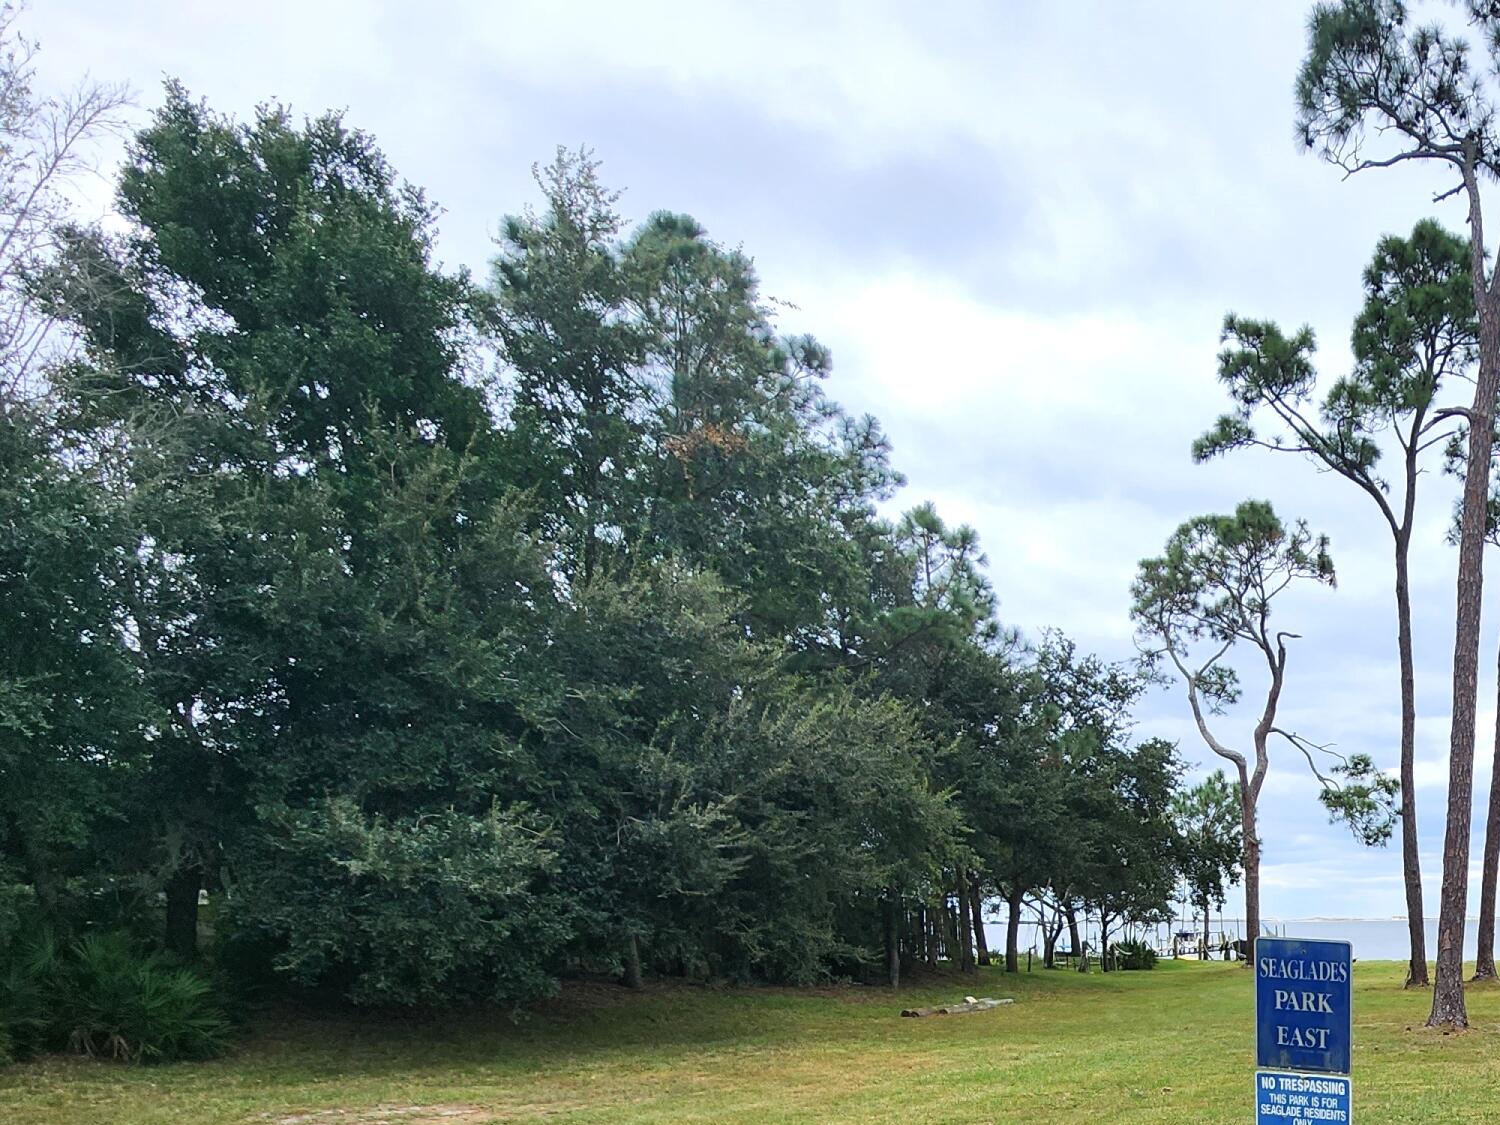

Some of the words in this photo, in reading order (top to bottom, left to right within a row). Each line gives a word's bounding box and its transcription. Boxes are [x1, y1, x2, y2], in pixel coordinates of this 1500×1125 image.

[1260, 957, 1347, 983] SEAGLADES
[1274, 990, 1334, 1013] PARK
[1277, 1025, 1330, 1049] EAST
[1261, 1077, 1275, 1090] NO
[1279, 1078, 1345, 1096] TRESPASSING
[1269, 1094, 1287, 1105] THIS
[1289, 1094, 1309, 1106] PARK
[1312, 1097, 1320, 1108] IS
[1322, 1097, 1338, 1109] FOR
[1261, 1105, 1302, 1117] SEAGLADE
[1304, 1108, 1346, 1121] RESIDENTS
